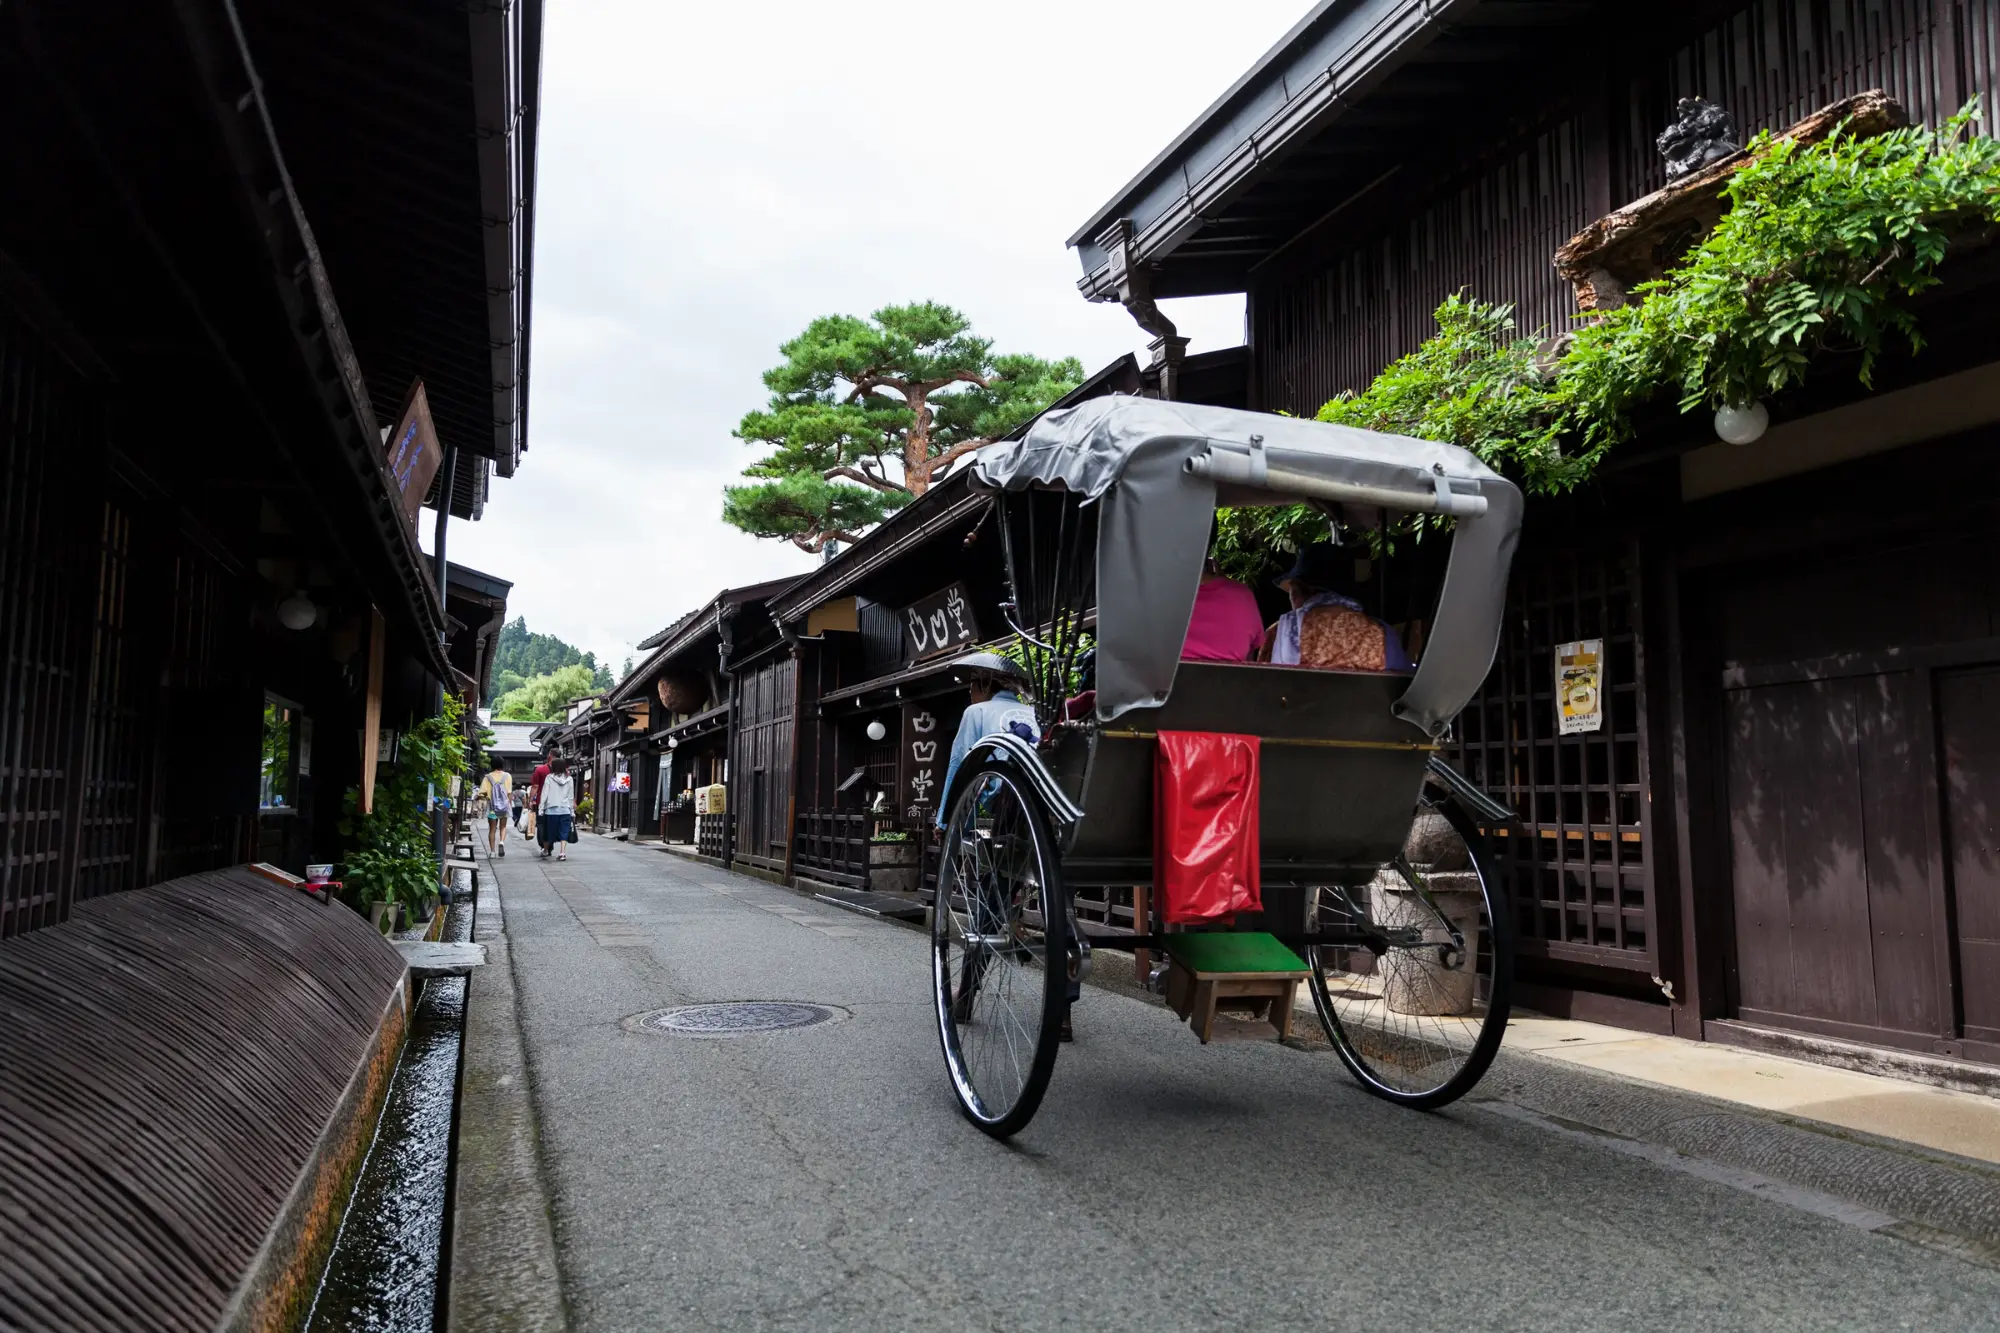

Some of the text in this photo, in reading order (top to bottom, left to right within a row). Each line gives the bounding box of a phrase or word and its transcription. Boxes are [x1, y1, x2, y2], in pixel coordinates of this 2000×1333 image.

[908, 588, 969, 652] 凸凹堂
[911, 712, 937, 801] 凸凹堂
